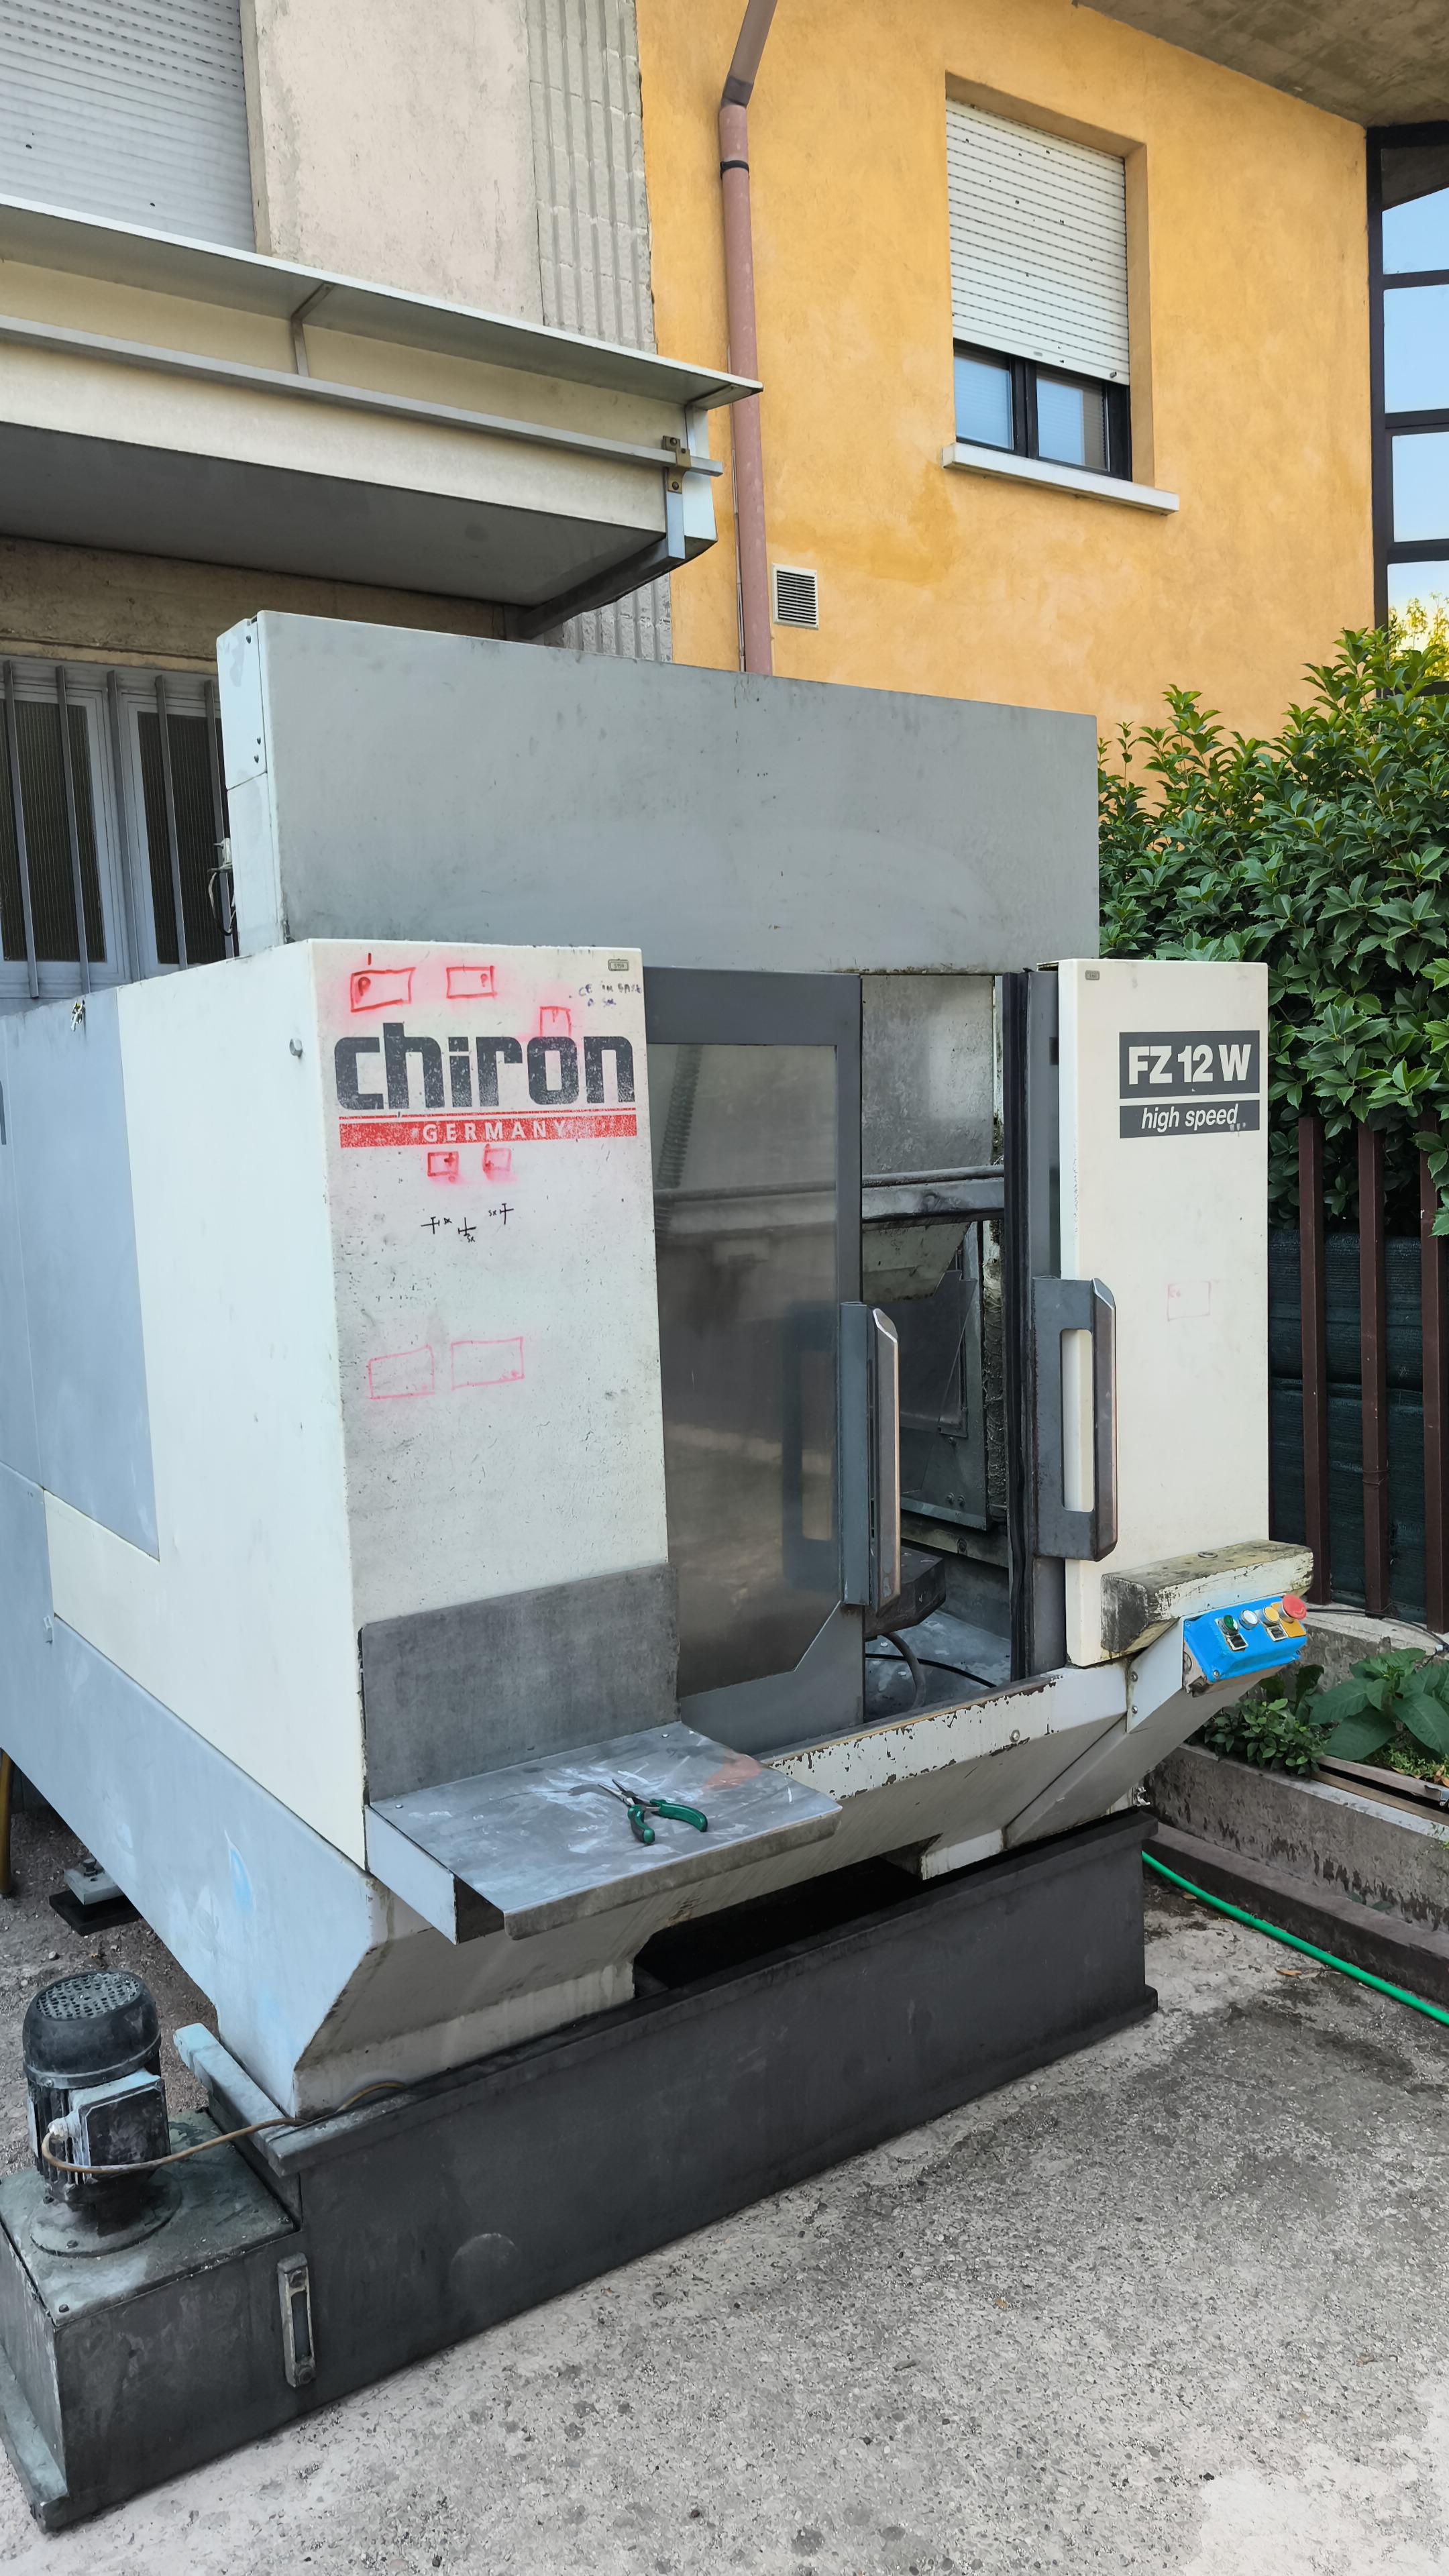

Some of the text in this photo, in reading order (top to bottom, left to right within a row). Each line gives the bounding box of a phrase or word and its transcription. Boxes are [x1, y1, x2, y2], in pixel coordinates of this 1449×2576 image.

[334, 1022, 636, 1110] chiron
[1128, 1044, 1252, 1085] FZ 12 W
[422, 1120, 566, 1142] GERMANY
[1141, 1103, 1239, 1133] high speed
